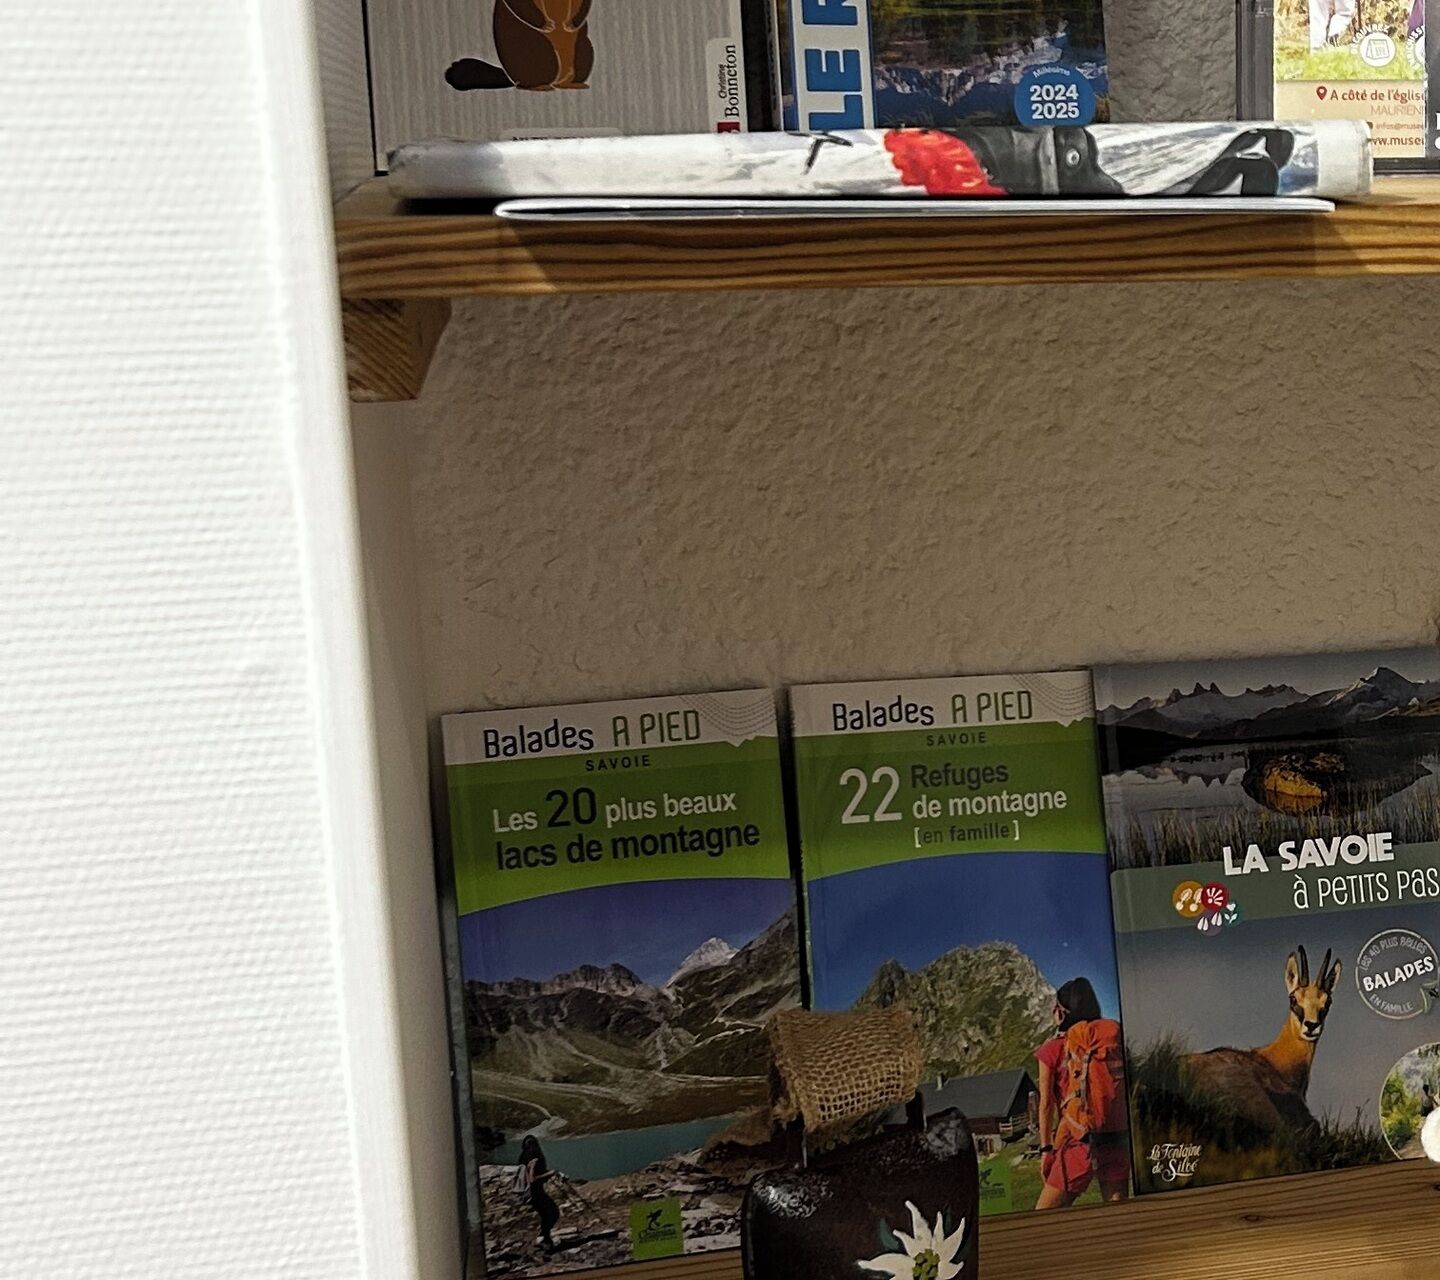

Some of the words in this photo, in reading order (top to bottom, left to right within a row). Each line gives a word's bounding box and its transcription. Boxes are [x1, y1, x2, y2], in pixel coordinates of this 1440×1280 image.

[724, 44, 740, 118] Bonneton
[804, 48, 864, 129] LE
[1029, 84, 1079, 101] 2024
[1341, 89, 1367, 101] côté
[1370, 89, 1385, 101] de
[1031, 102, 1080, 120] 2025
[832, 695, 935, 731] Balades
[951, 693, 967, 724] A
[977, 690, 1033, 722] PIED
[483, 719, 594, 759] Balades
[612, 715, 631, 747] A
[640, 710, 701, 744] PIED
[926, 732, 988, 747] SAVOIE
[585, 754, 651, 772] SAVOIE
[492, 808, 538, 833] Les
[545, 786, 598, 828] 20
[605, 796, 657, 828] plus
[663, 792, 737, 818] beaux
[839, 766, 903, 825] 22
[911, 763, 1009, 791] Refuges
[912, 794, 942, 819] de
[949, 789, 1068, 818] montagne
[496, 838, 557, 870] lacs
[566, 833, 603, 863] de
[611, 822, 760, 859] montagne
[1222, 843, 1269, 876] LA
[1278, 831, 1395, 871] SAVOIE
[1293, 874, 1309, 909] à
[1362, 956, 1434, 992] BALADES
